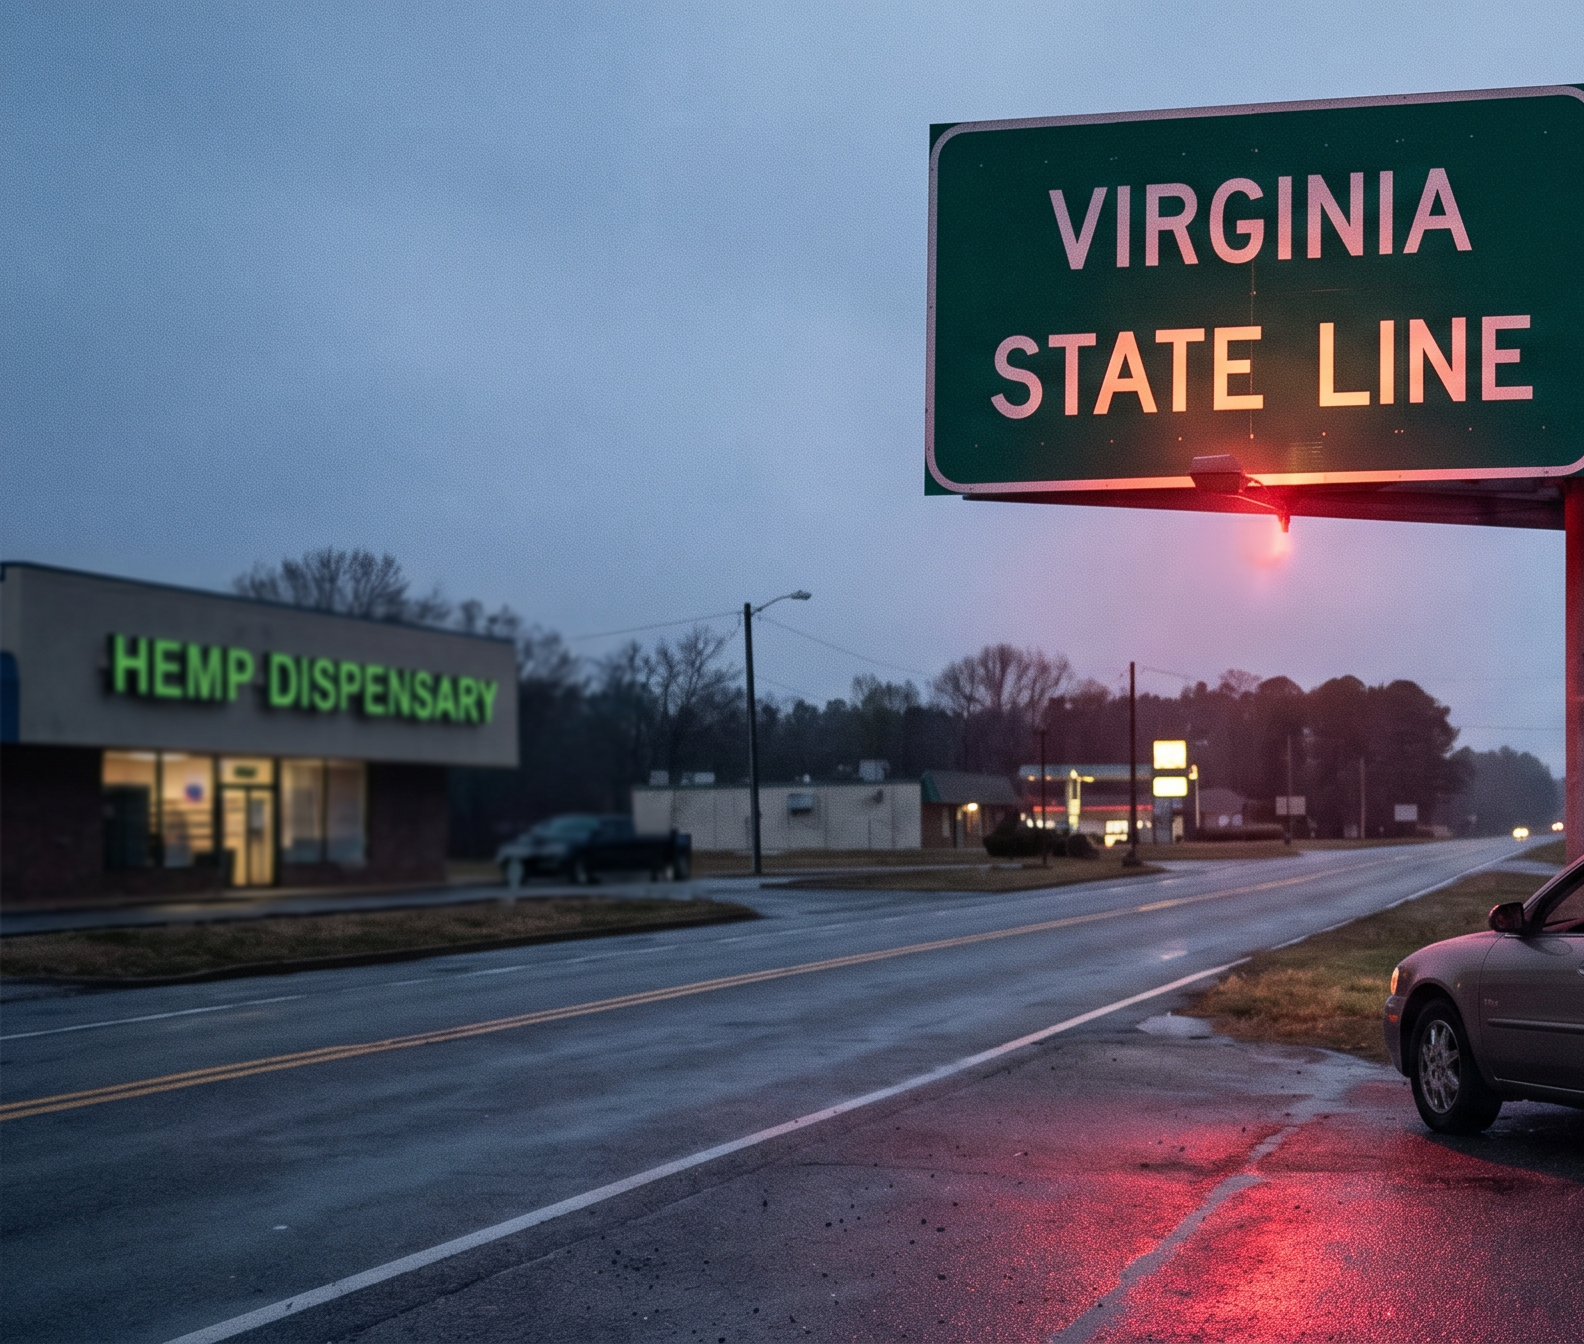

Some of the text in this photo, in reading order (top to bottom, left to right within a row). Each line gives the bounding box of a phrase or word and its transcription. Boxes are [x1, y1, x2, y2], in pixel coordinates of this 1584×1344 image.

[1049, 168, 1472, 270] VIRGINIA
[991, 315, 1534, 419] STATE LINE
[113, 633, 498, 724] HEMP DISPENSARY
